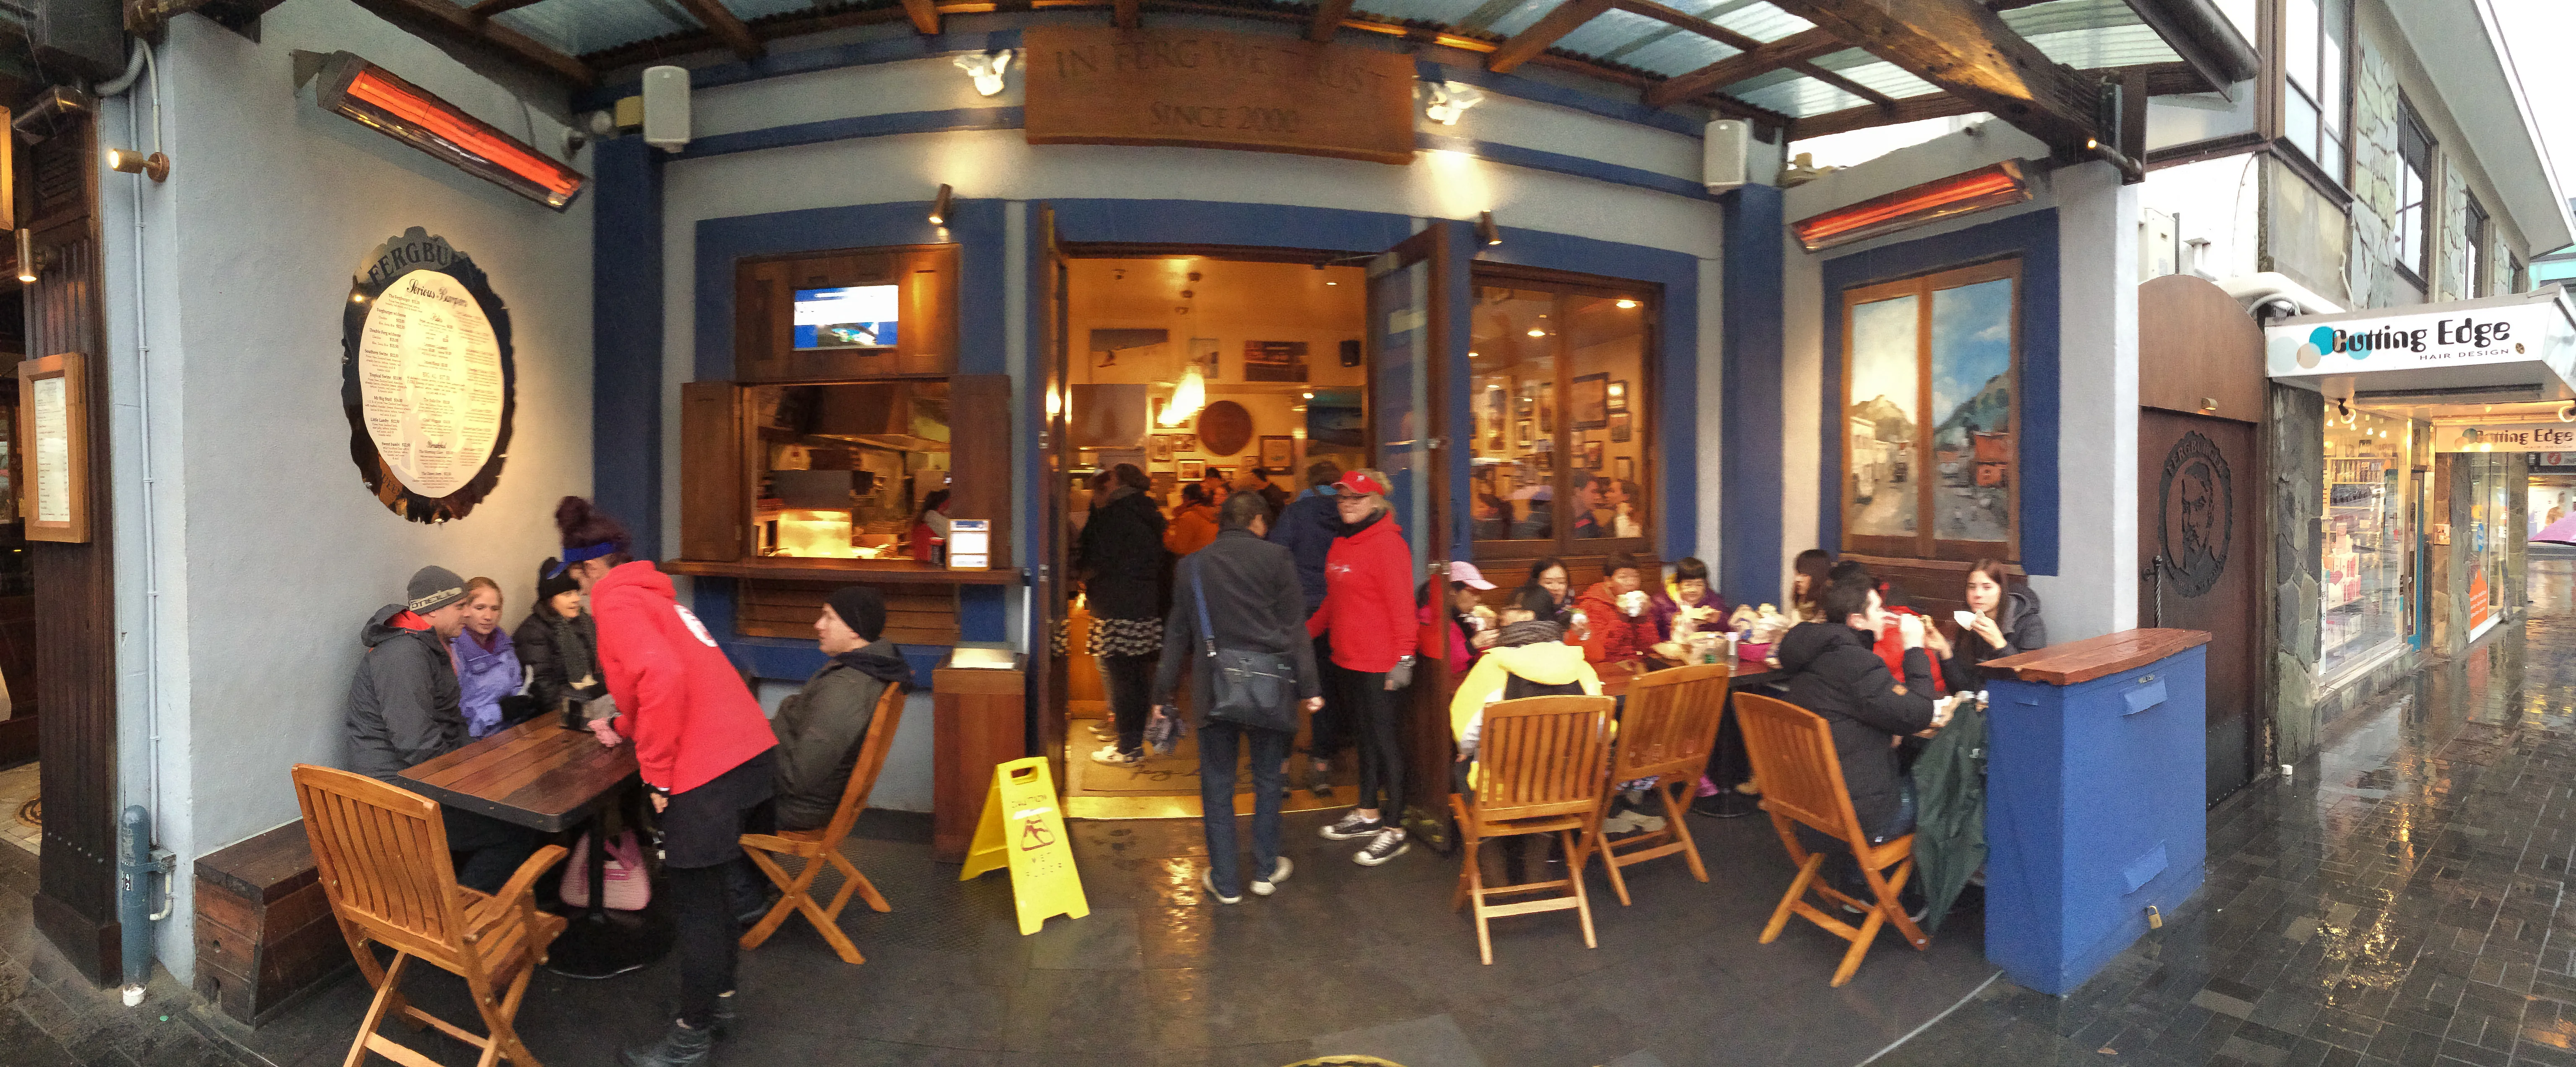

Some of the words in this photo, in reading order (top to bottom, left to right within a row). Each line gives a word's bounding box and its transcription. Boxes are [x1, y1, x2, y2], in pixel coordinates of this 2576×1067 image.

[2332, 325, 2428, 354] Cutting
[2438, 318, 2510, 348] Edge
[2459, 349, 2509, 357] DESIGN
[2534, 428, 2574, 445] Edge
